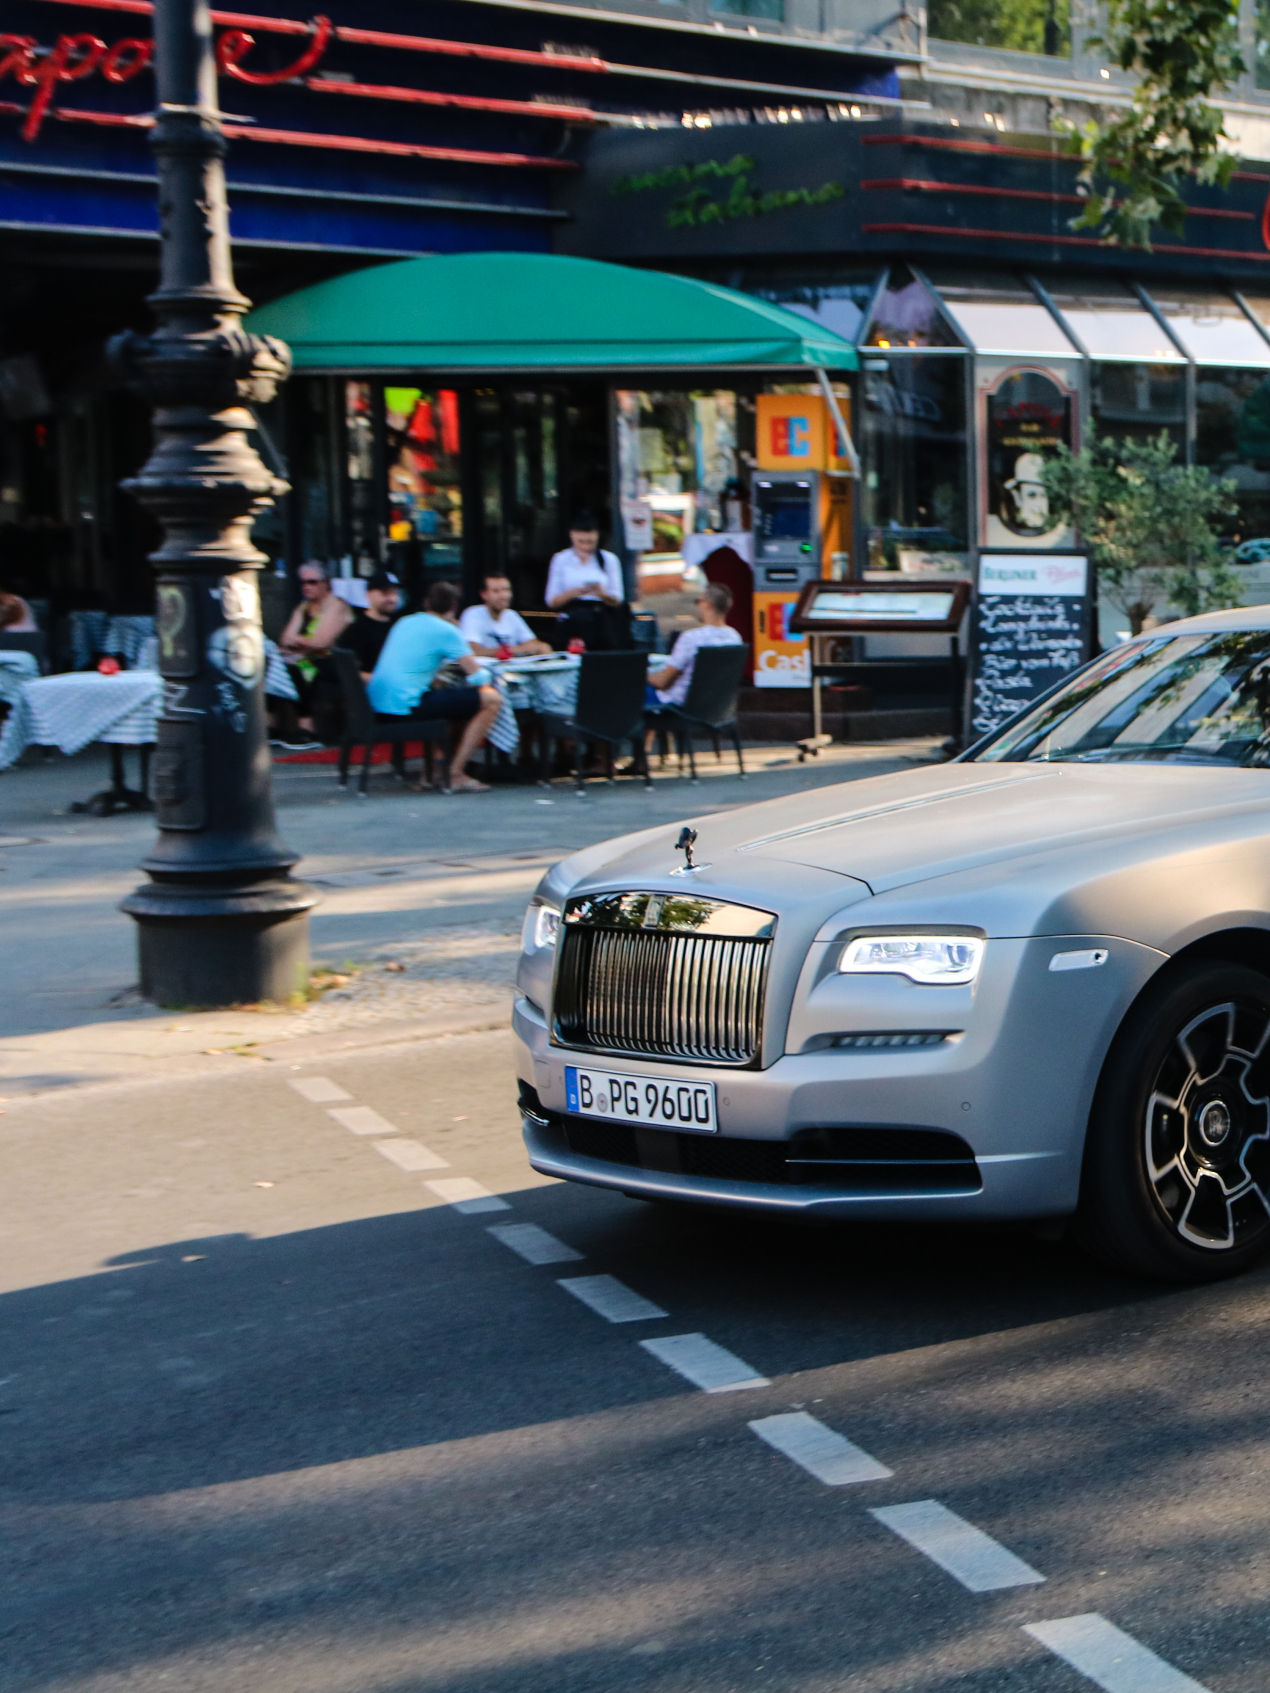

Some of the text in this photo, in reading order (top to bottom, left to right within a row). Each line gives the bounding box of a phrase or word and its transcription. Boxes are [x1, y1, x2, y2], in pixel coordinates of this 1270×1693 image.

[770, 415, 810, 456] EC
[580, 1074, 710, 1124] B PG 9600
